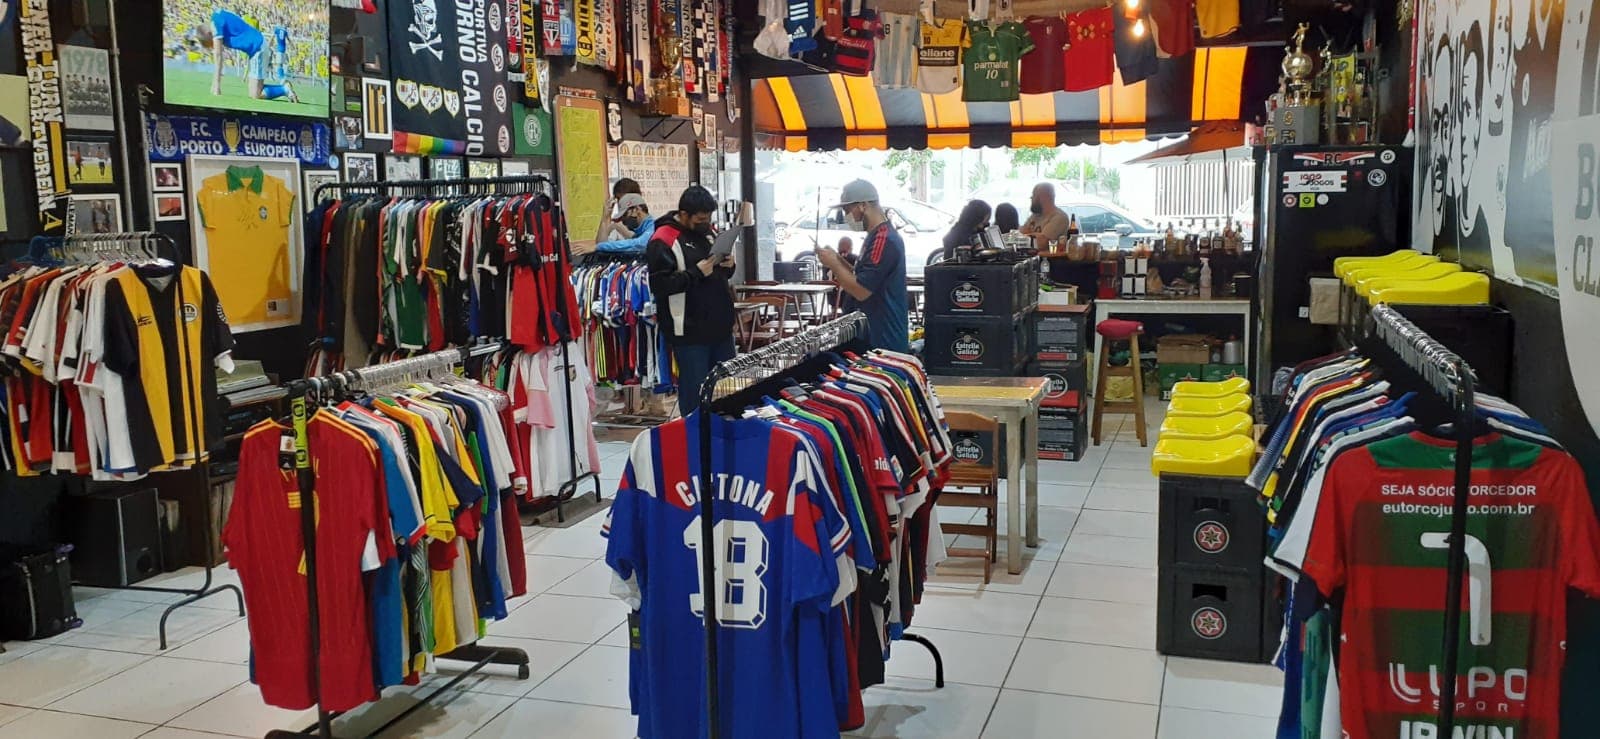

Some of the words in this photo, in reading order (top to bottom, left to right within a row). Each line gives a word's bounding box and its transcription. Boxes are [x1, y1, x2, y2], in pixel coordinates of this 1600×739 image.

[523, 24, 536, 54] AFC
[919, 48, 955, 57] eliane
[974, 61, 1009, 71] parmalat
[985, 69, 999, 80] 10
[38, 60, 63, 122] TURN
[461, 69, 485, 156] CALCIO
[190, 121, 212, 137] F.C.
[241, 125, 297, 144] CAMPEÃO
[26, 66, 57, 212] SPORTVEREIN
[179, 139, 223, 155] PORTO
[243, 142, 297, 159] EUROPEU
[675, 472, 774, 516] CTONA
[1381, 484, 1415, 495] SEJA
[1468, 485, 1536, 496] ORCEDOR
[1382, 502, 1535, 517] eutorcojuo.com.br
[683, 514, 770, 629] 18
[1432, 701, 1525, 713] SPOR
